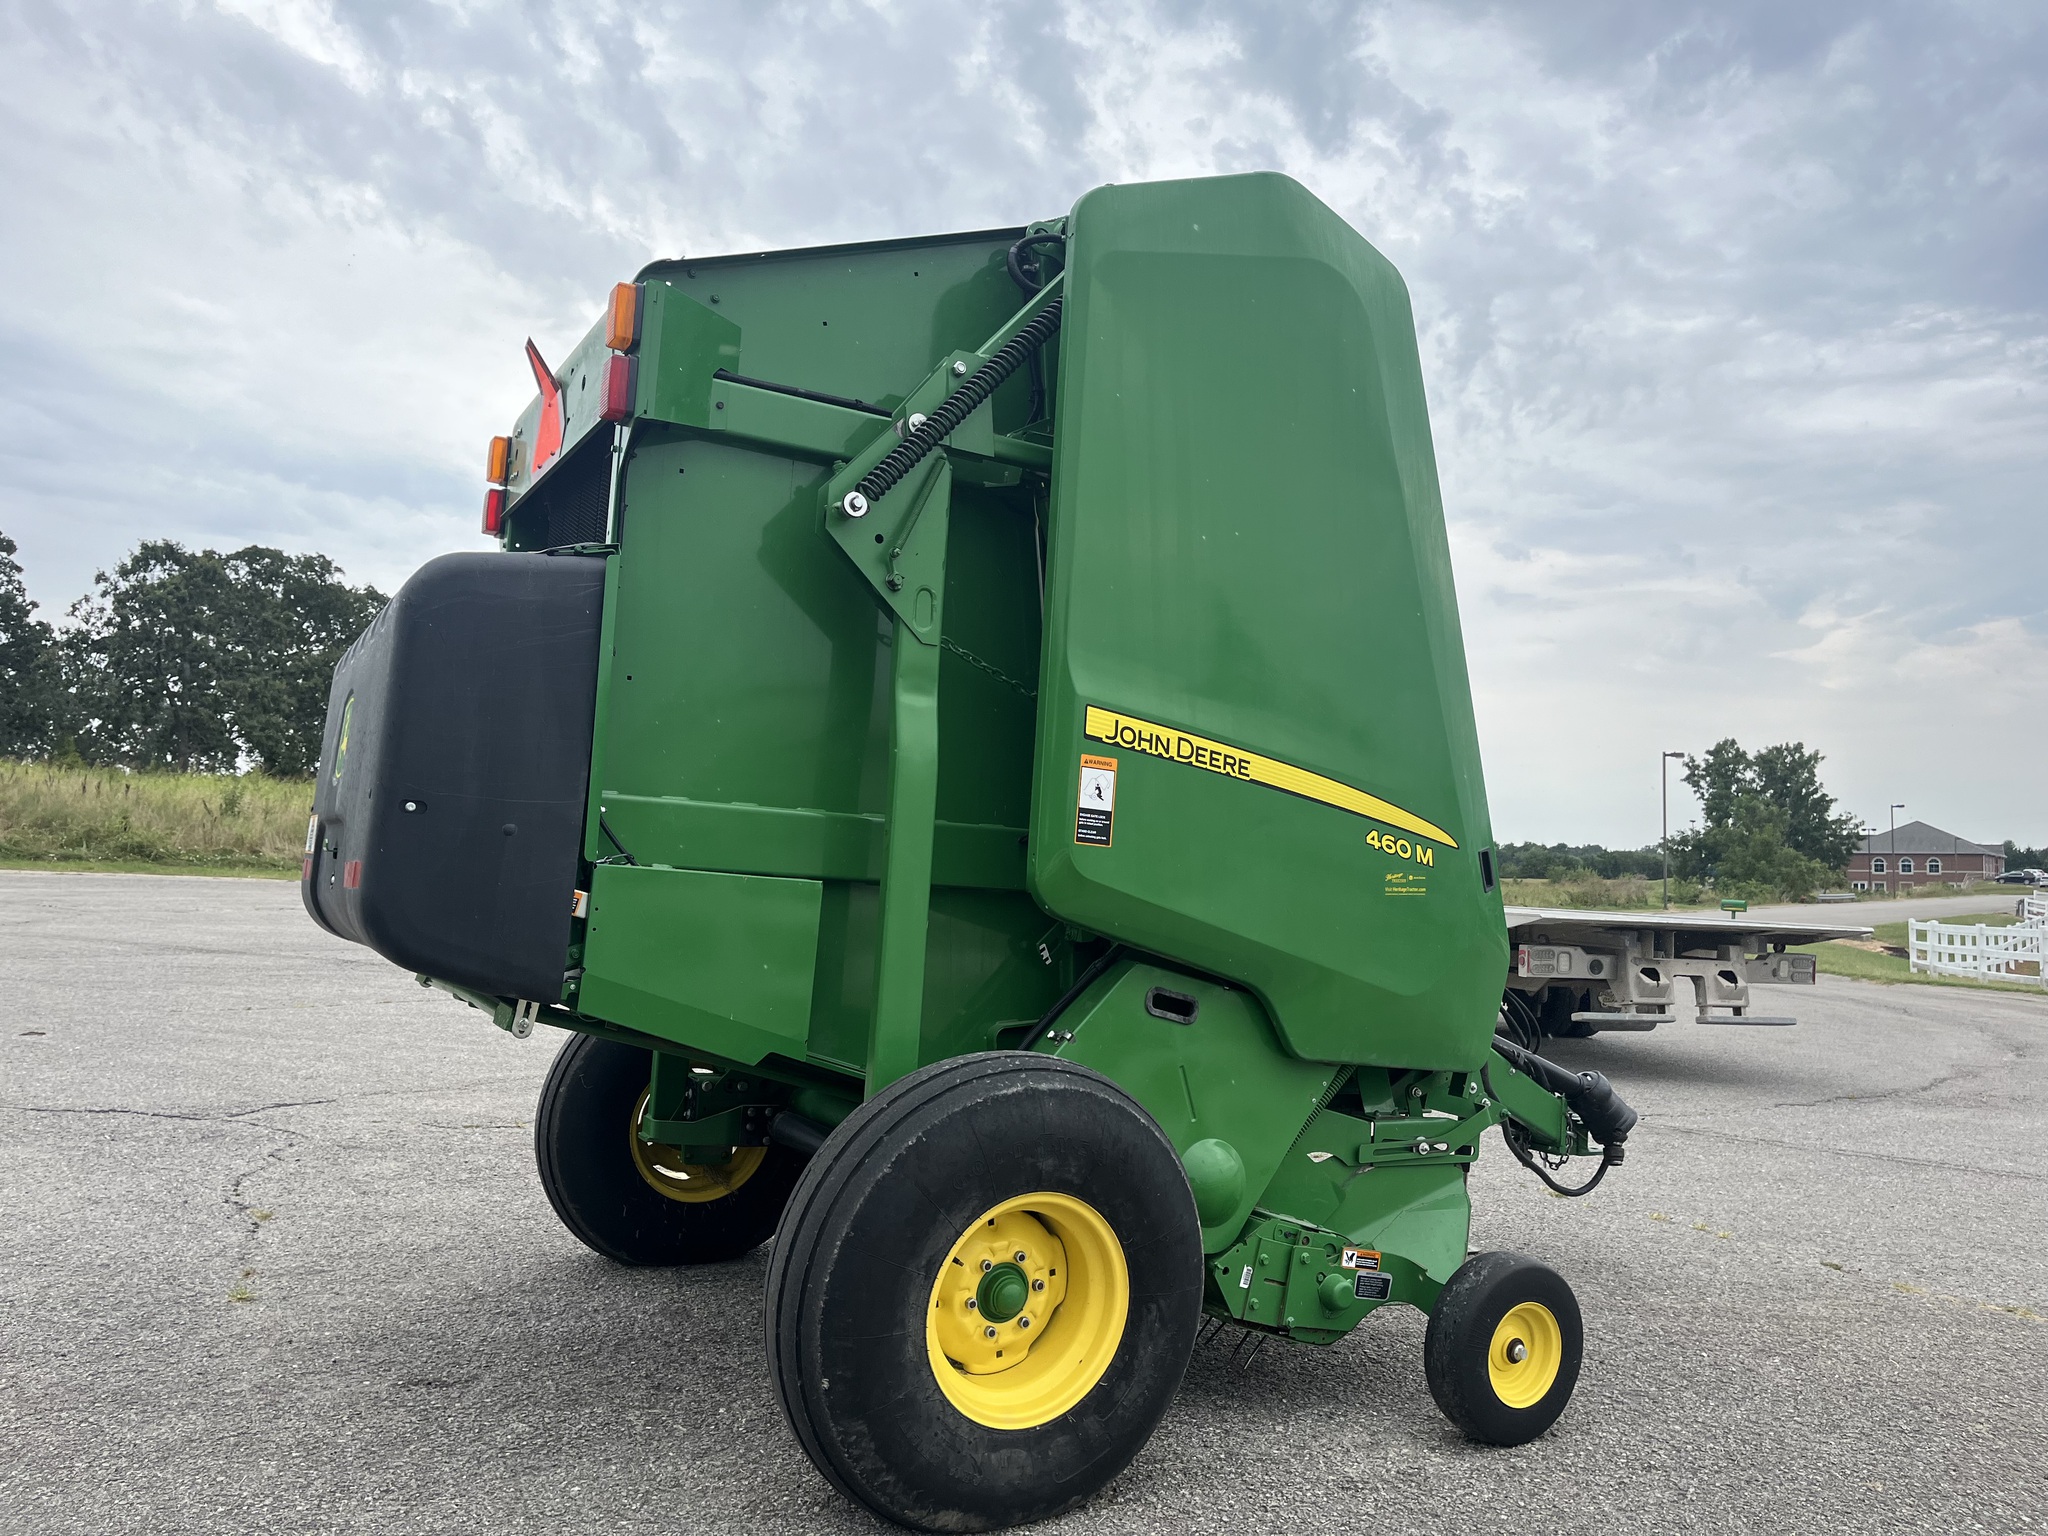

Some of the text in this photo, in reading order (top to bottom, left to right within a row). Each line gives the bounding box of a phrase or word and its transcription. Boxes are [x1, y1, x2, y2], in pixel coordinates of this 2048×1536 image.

[1089, 759, 1113, 768] WARNING
[1105, 719, 1251, 778] JOHN DEERE
[1366, 830, 1433, 867] 460 M
